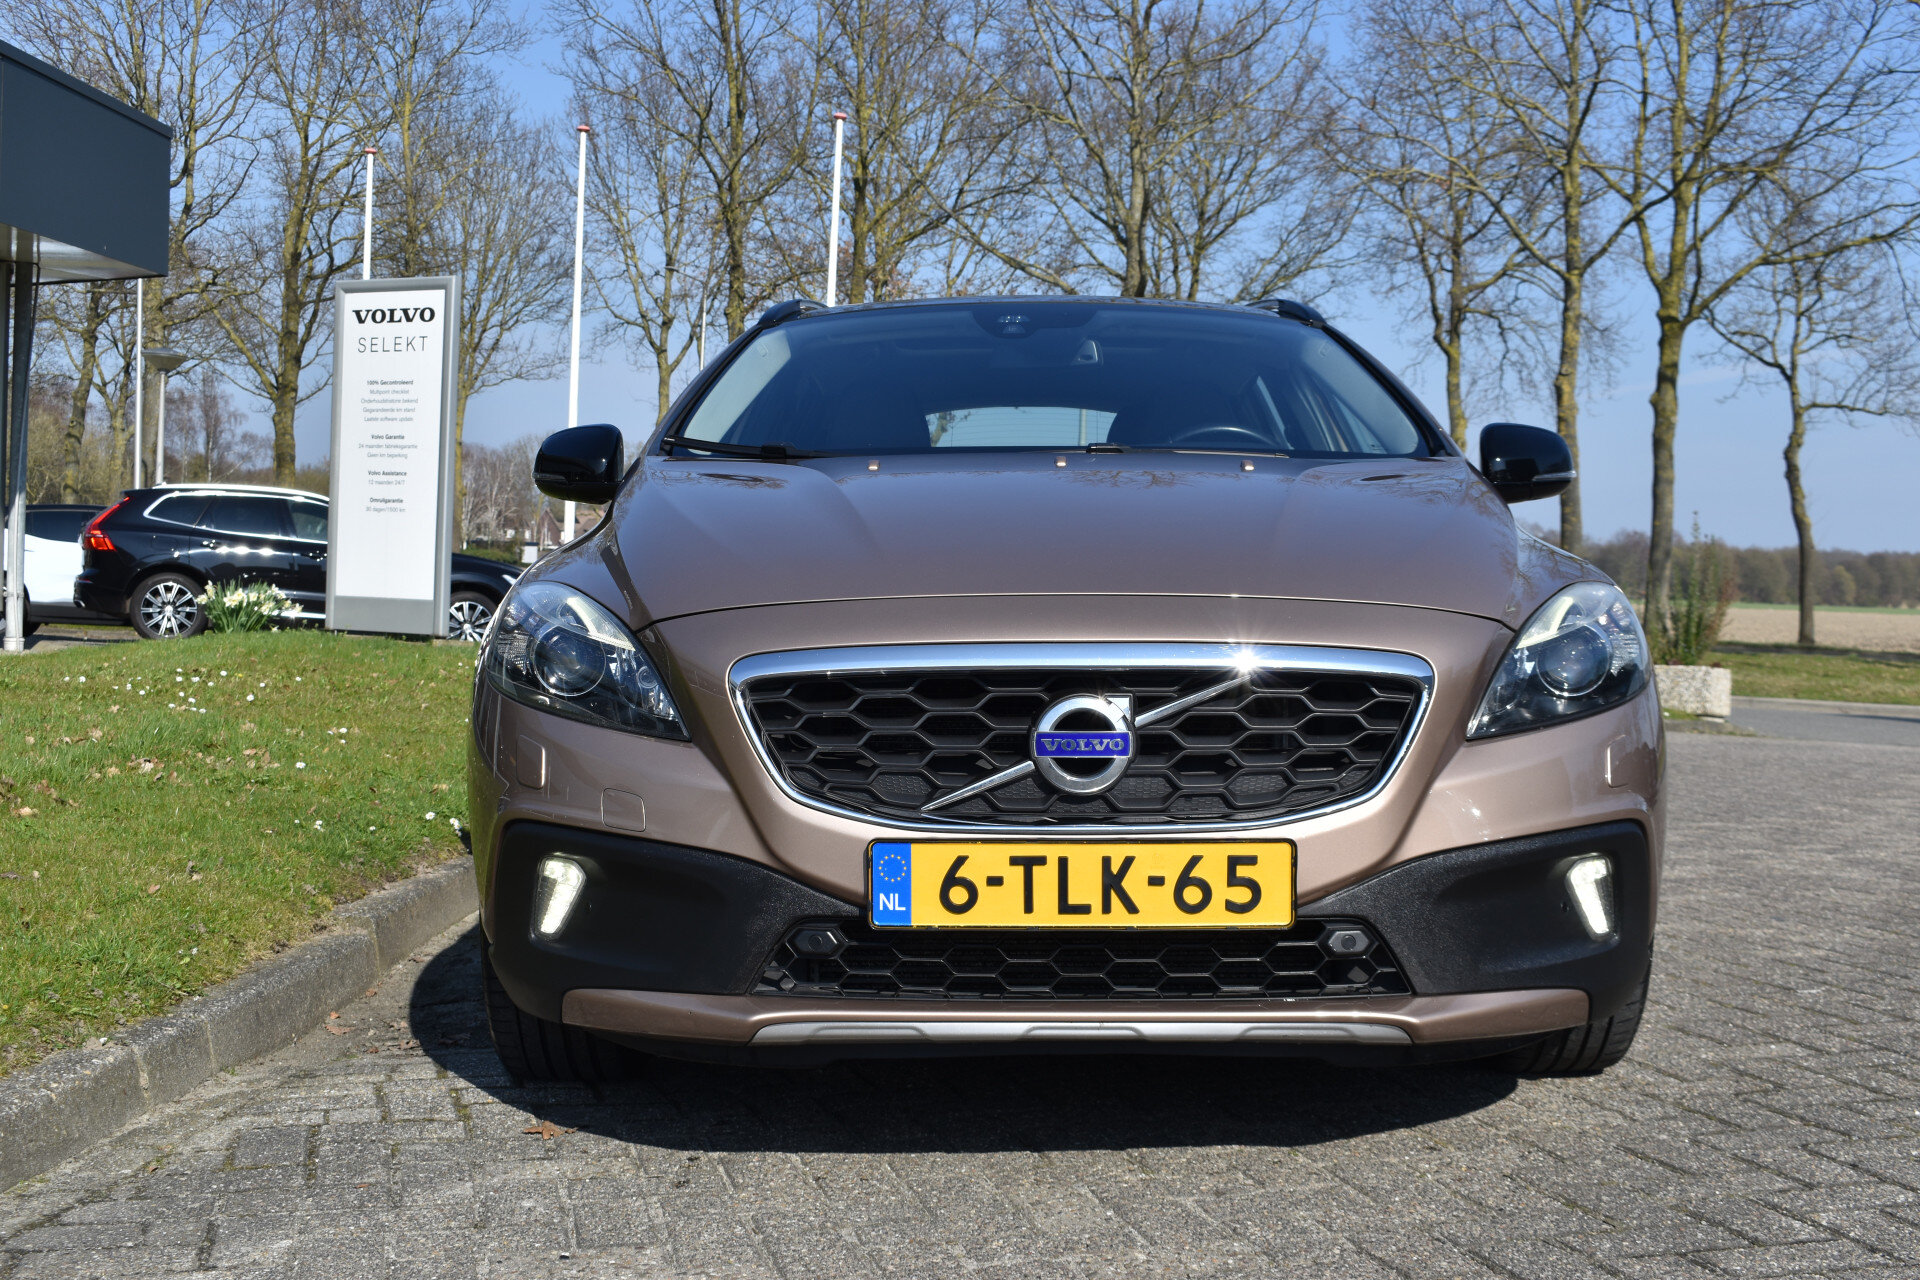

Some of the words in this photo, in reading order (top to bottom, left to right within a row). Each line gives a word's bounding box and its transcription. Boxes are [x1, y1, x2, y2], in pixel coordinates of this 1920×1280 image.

[352, 307, 435, 324] VOLVO
[358, 336, 428, 353] SELEKT
[1041, 739, 1124, 751] VOLVO
[939, 855, 1262, 914] 6-TLK-65
[879, 893, 906, 911] NL
